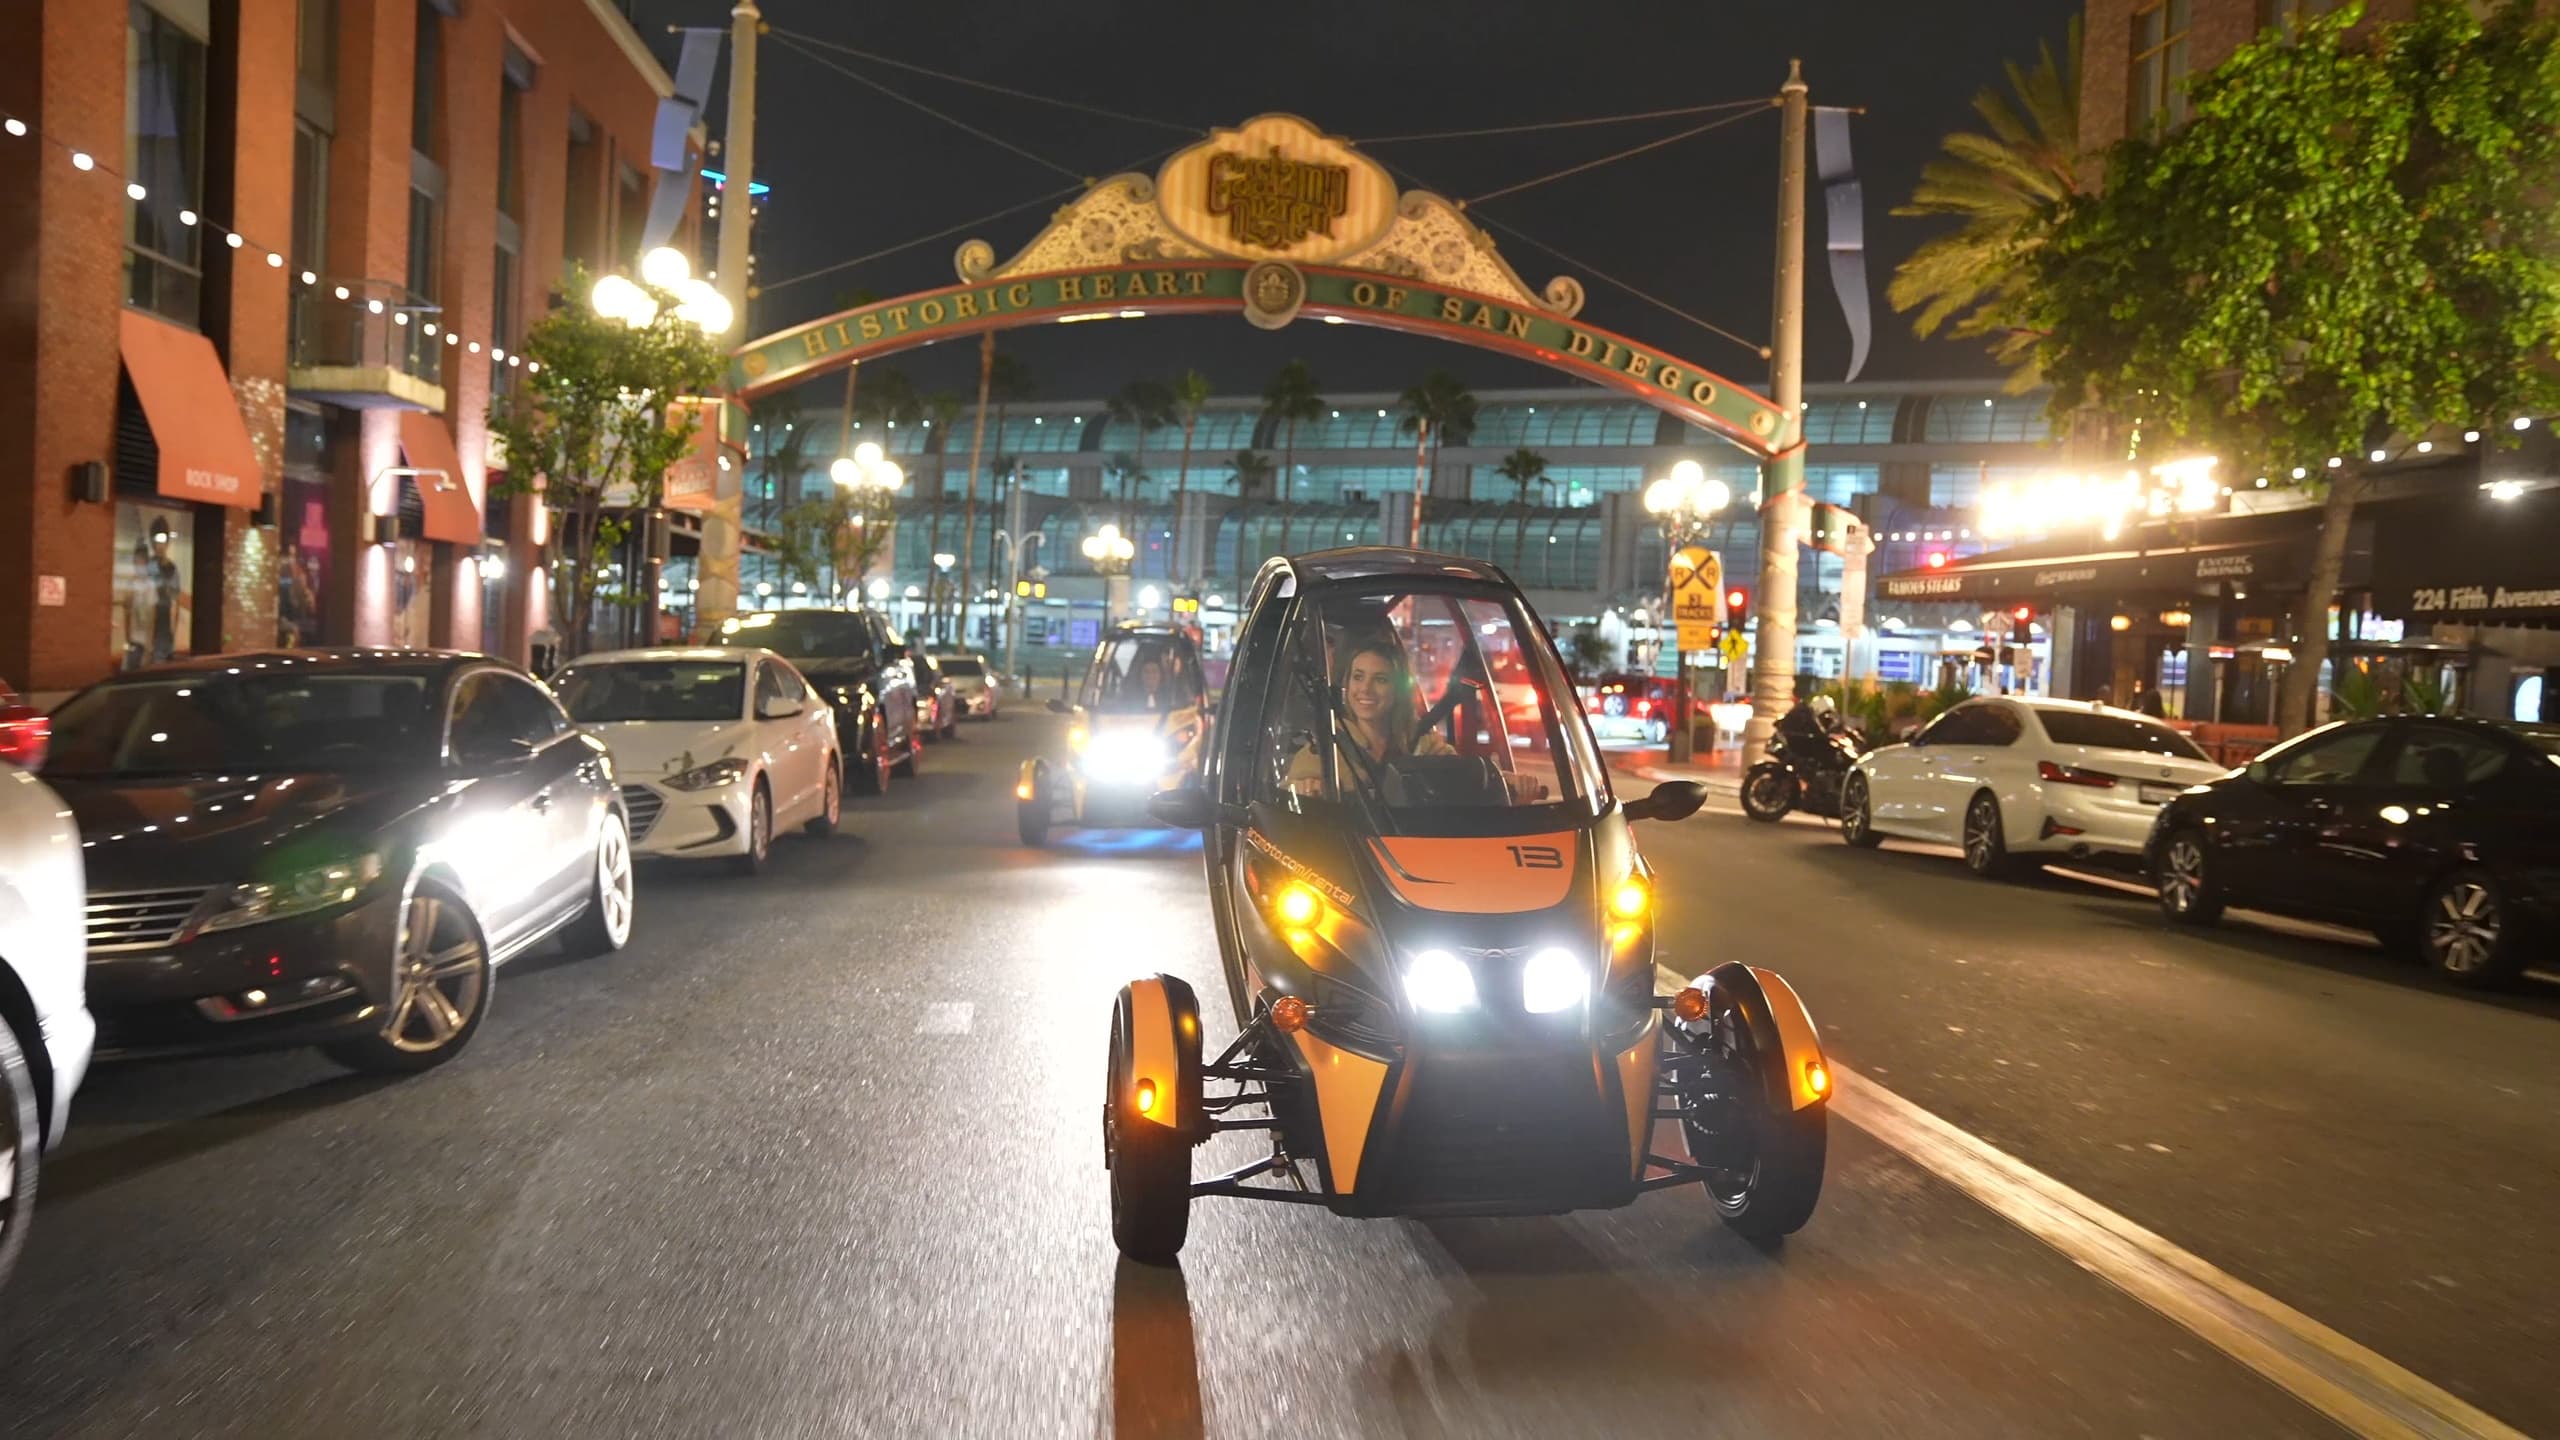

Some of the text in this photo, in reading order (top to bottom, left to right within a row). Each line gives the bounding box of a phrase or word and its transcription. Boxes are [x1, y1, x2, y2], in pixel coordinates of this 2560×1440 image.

[1208, 145, 1349, 217] Gaslamp
[803, 271, 1718, 406] HISTORIC HEART OF SAN DIEGO
[186, 468, 239, 493] ROCK SHOP
[1675, 567, 1716, 578] R R
[2196, 564, 2254, 577] DRINKS
[2198, 555, 2252, 567] EXOTIC
[1888, 577, 1962, 596] FAMOUS STEAKS
[2413, 586, 2560, 611] 224 Fifth Avenue
[1506, 845, 1563, 869] 13
